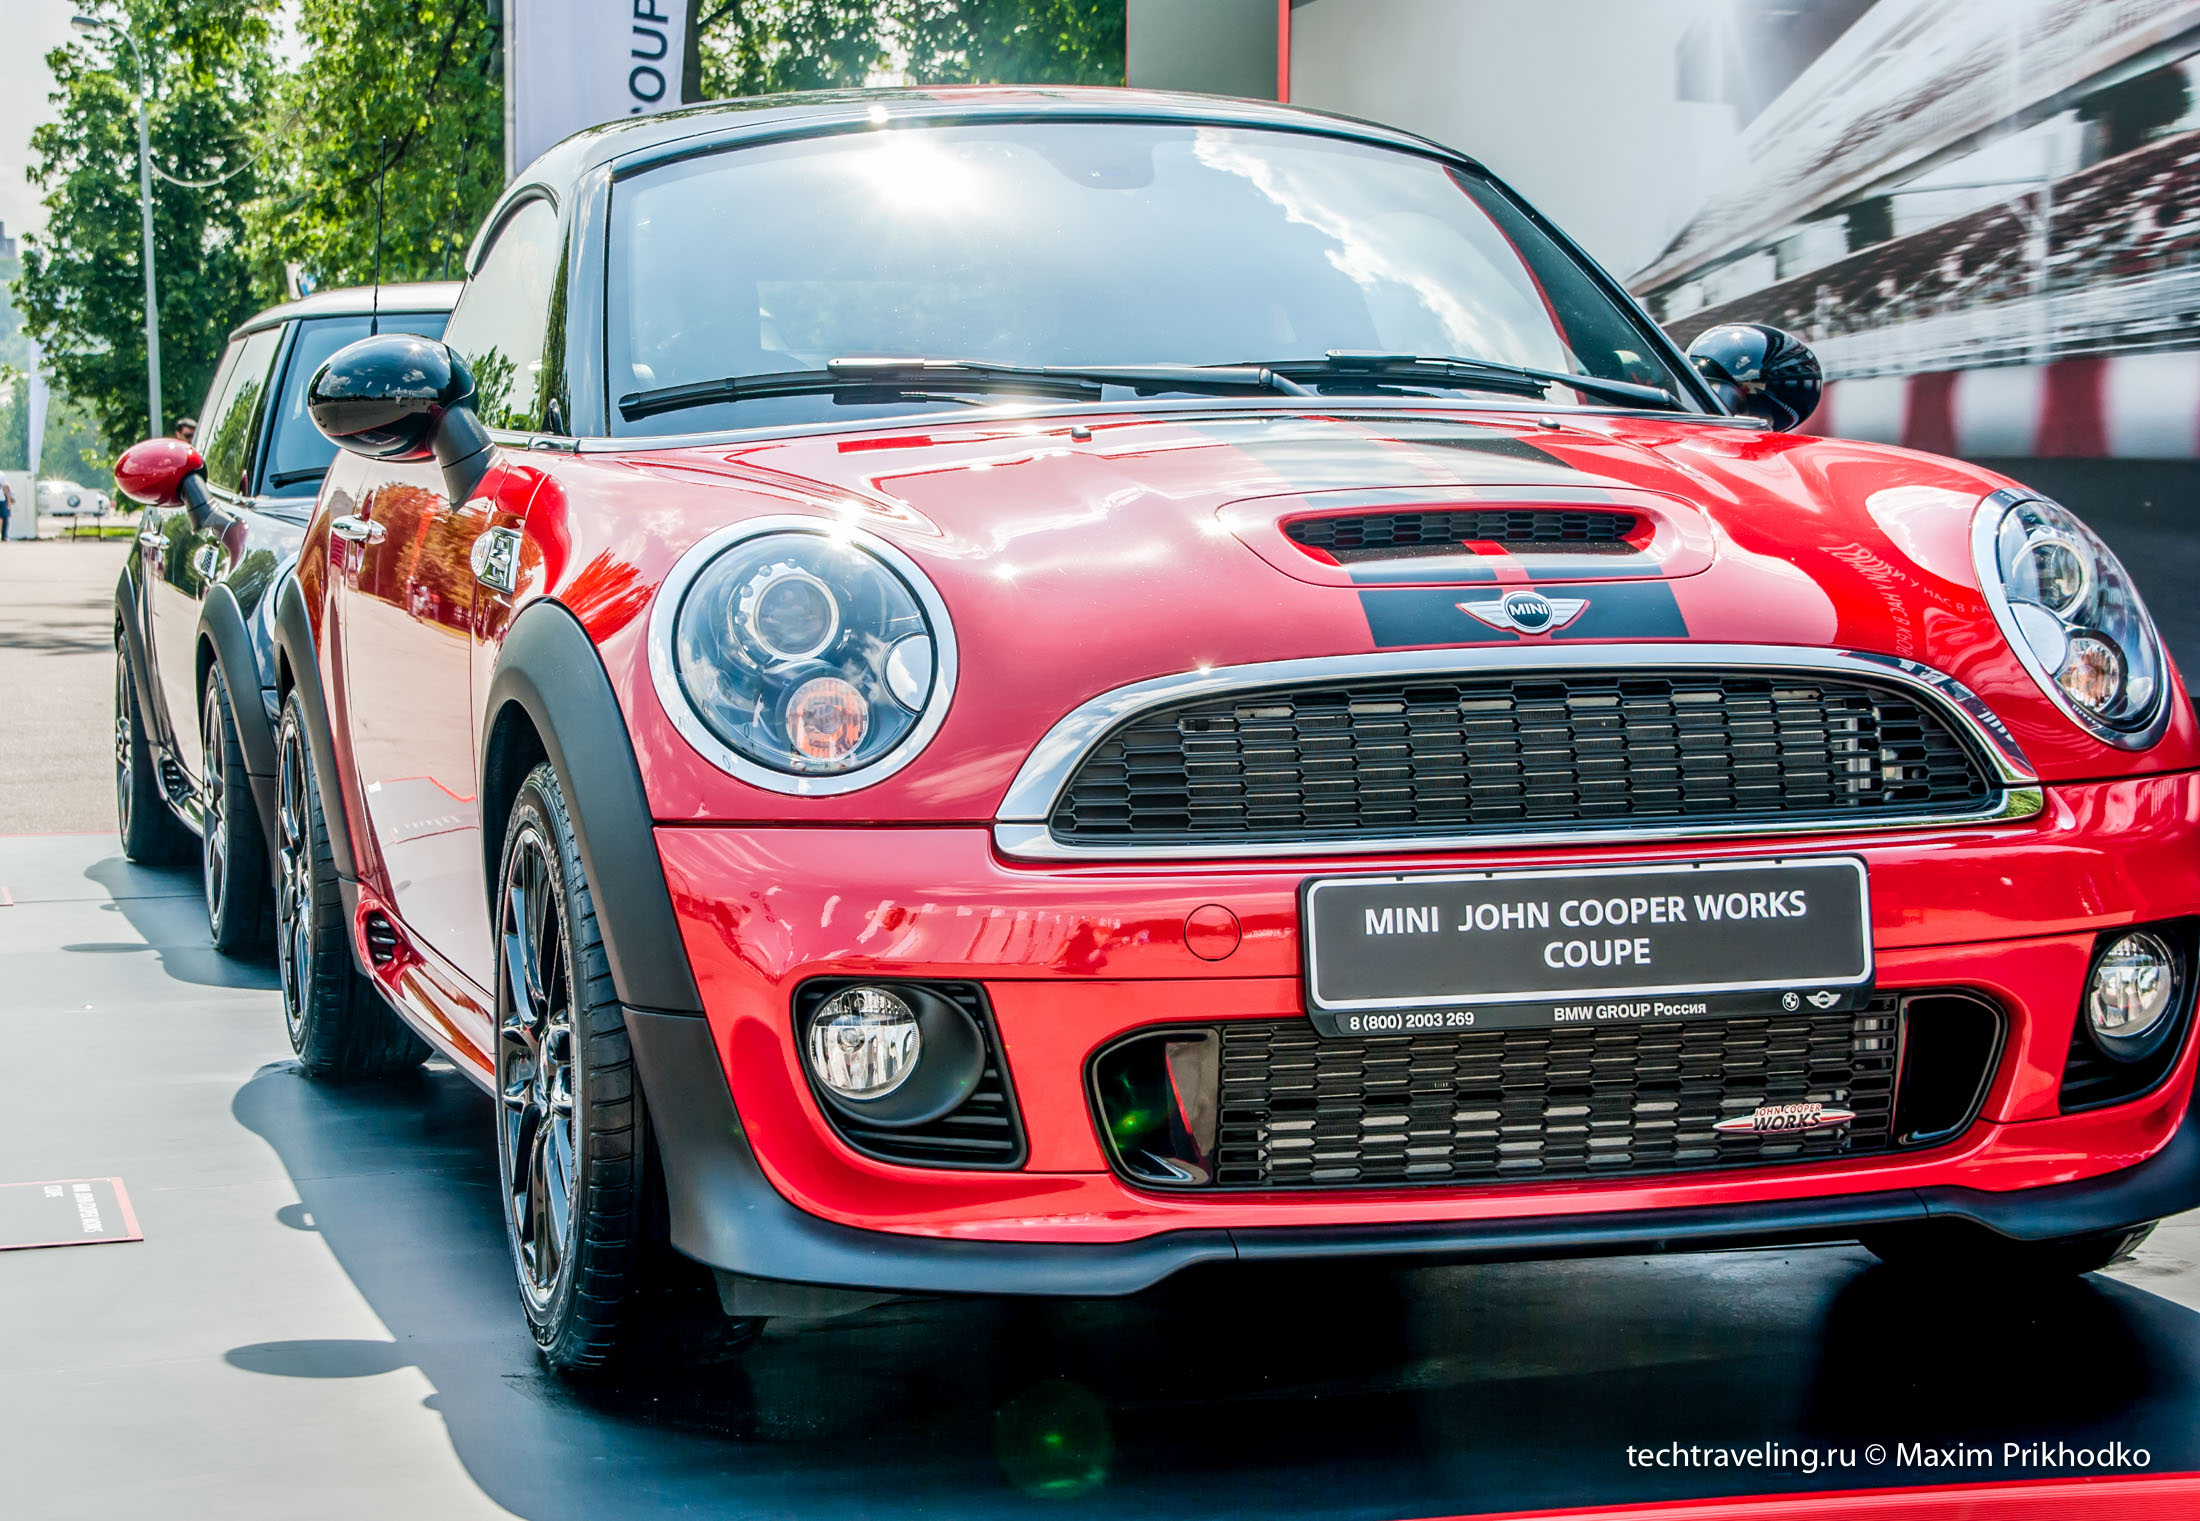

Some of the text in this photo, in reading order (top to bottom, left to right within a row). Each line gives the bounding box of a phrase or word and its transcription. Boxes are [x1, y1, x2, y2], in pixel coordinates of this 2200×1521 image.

[628, 0, 669, 115] OUP
[1508, 602, 1548, 615] MINI
[1365, 890, 1807, 936] MINI JOHN COOPER WORKS
[1543, 937, 1651, 969] COUPE
[1349, 1011, 1475, 1031] 8 (800) 2003 269
[1553, 1002, 1707, 1022] BMW GROUP Россия
[1754, 1103, 1821, 1116] JOHN COOPER
[1753, 1112, 1821, 1131] WORKS
